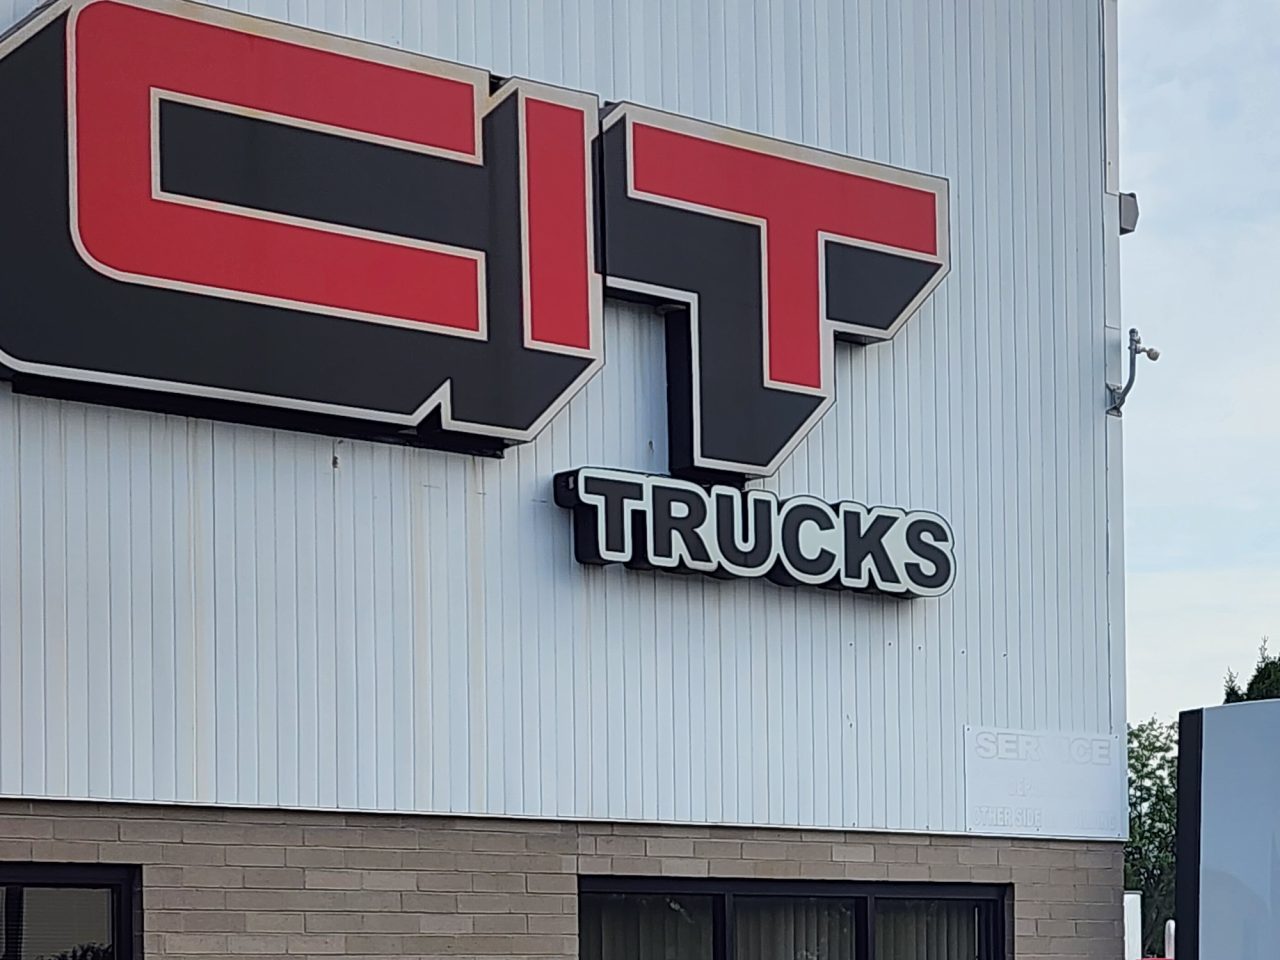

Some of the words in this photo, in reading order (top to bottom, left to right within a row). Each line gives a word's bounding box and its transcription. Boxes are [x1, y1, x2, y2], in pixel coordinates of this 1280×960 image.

[70, 0, 951, 396] CIT
[582, 474, 953, 591] TRUCKS
[975, 730, 1112, 766] SERICE
